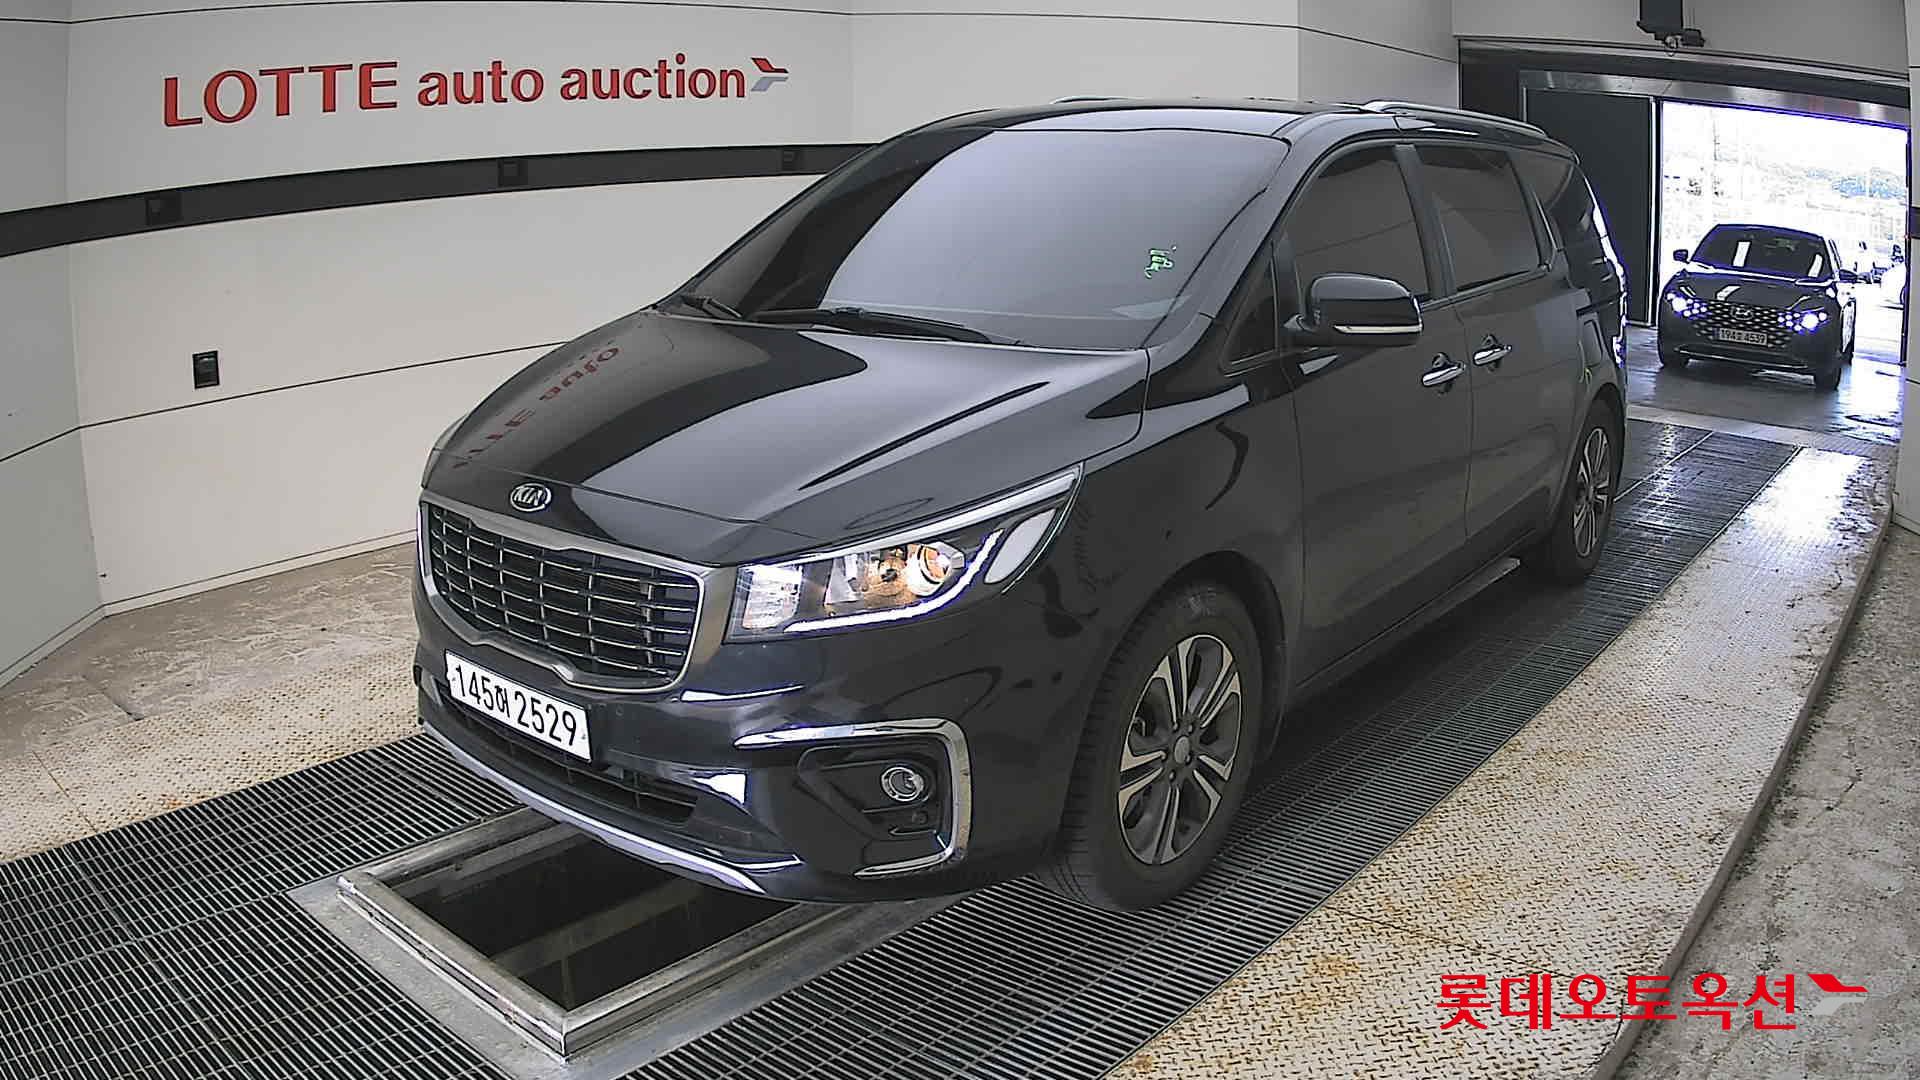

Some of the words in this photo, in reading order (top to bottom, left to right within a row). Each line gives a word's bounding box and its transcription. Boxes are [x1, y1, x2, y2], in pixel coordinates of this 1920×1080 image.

[163, 61, 398, 127] LOTTE
[417, 60, 544, 107] auto
[560, 53, 746, 100] auction
[456, 664, 510, 718] 145허
[514, 691, 577, 747] 2529
